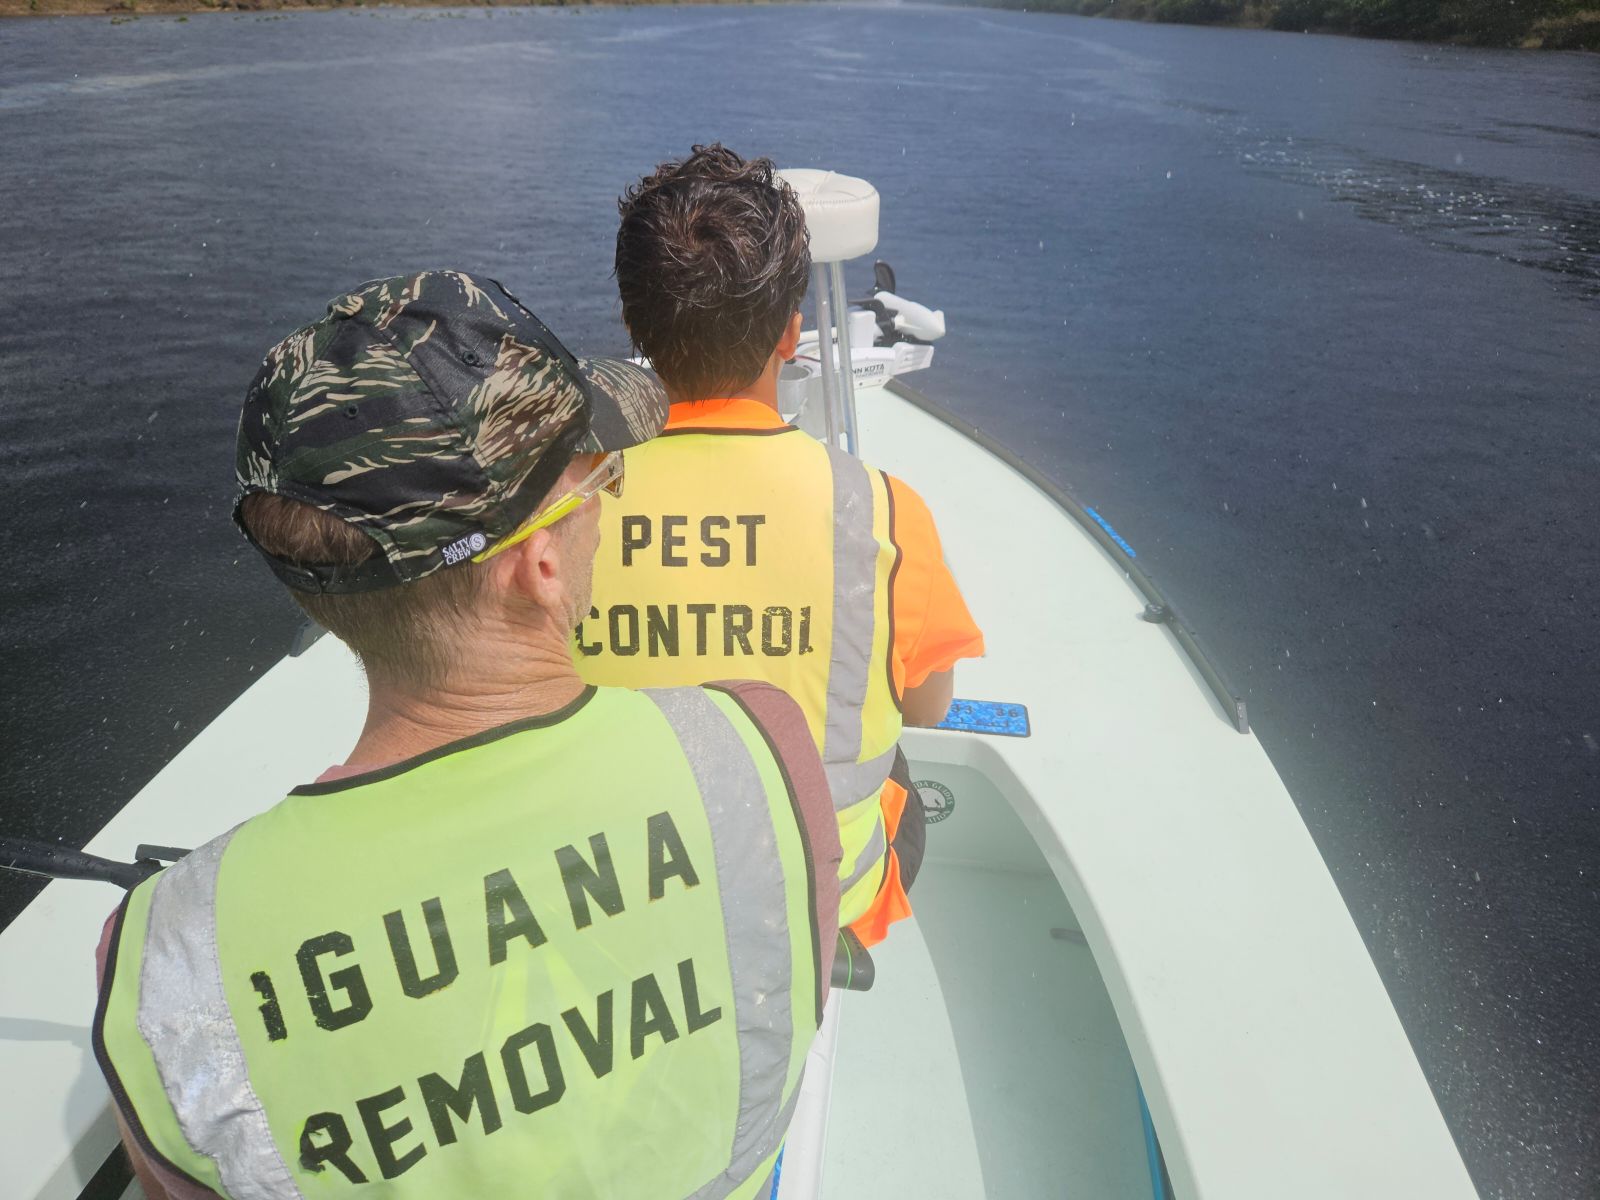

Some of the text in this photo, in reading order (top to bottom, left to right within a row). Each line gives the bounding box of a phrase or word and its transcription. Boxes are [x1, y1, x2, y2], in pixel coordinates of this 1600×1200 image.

[864, 363, 885, 372] KOTA
[442, 537, 470, 557] SALTY
[446, 547, 471, 566] CREW
[622, 515, 766, 567] PEST
[249, 811, 700, 1042] IGUANA
[299, 958, 722, 1184] REMOVAL
